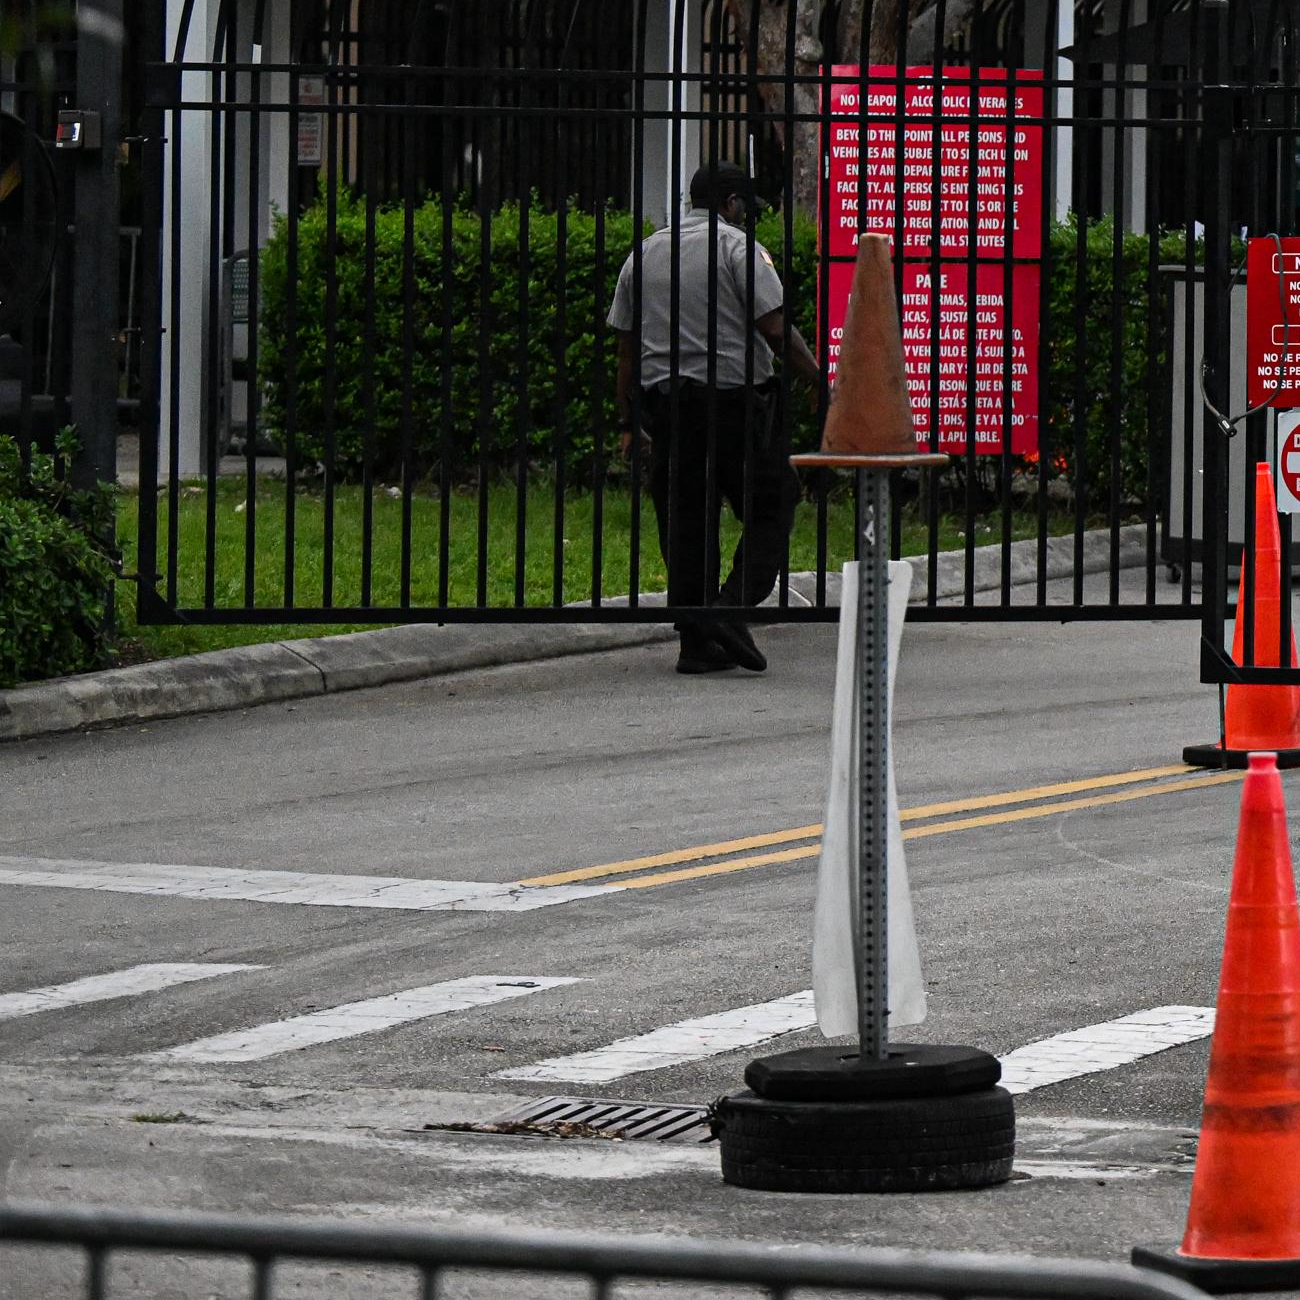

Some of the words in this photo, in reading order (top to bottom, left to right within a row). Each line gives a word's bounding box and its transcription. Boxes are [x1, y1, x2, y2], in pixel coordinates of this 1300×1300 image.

[841, 94, 855, 106] NO
[912, 96, 965, 108] ALCOOLIC
[958, 131, 1002, 143] PESONS
[1004, 132, 1026, 143] ND
[832, 146, 879, 159] VEHIES
[904, 148, 944, 160] SUBJET
[945, 148, 959, 160] TO
[960, 148, 998, 160] SRCH
[1001, 149, 1028, 161] UON
[846, 164, 878, 176] ENRY
[904, 165, 961, 177] DEPAURE
[837, 181, 882, 194] FACITY.
[904, 182, 949, 194] PERSS
[950, 183, 999, 195] ENTRING
[1000, 184, 1024, 196] TIS
[841, 199, 884, 211] FACITY
[907, 199, 949, 212] SUBJT
[951, 200, 963, 212] TO
[987, 201, 1001, 212] OR
[840, 216, 884, 228] POLIES
[909, 217, 968, 229] REGATION
[978, 218, 1000, 230] AND
[959, 235, 1005, 247] STTUTES
[916, 274, 948, 289] PAE
[940, 311, 997, 324] SUSTACIAS
[926, 324, 950, 341] ALÁ
[953, 328, 965, 340] DE
[904, 345, 911, 357] Y
[912, 345, 959, 357] VEHULO
[1017, 347, 1025, 358] A
[1263, 353, 1278, 363] NO
[917, 363, 955, 374] ENRAR
[1257, 366, 1273, 376] NO
[906, 379, 926, 391] ODA
[993, 380, 1023, 392] ENRE
[1263, 380, 1278, 389] NO
[1280, 380, 1293, 389] SE
[943, 414, 965, 427] DHS,
[998, 414, 1025, 426] TDO
[947, 431, 1000, 443] APLIABLE.
